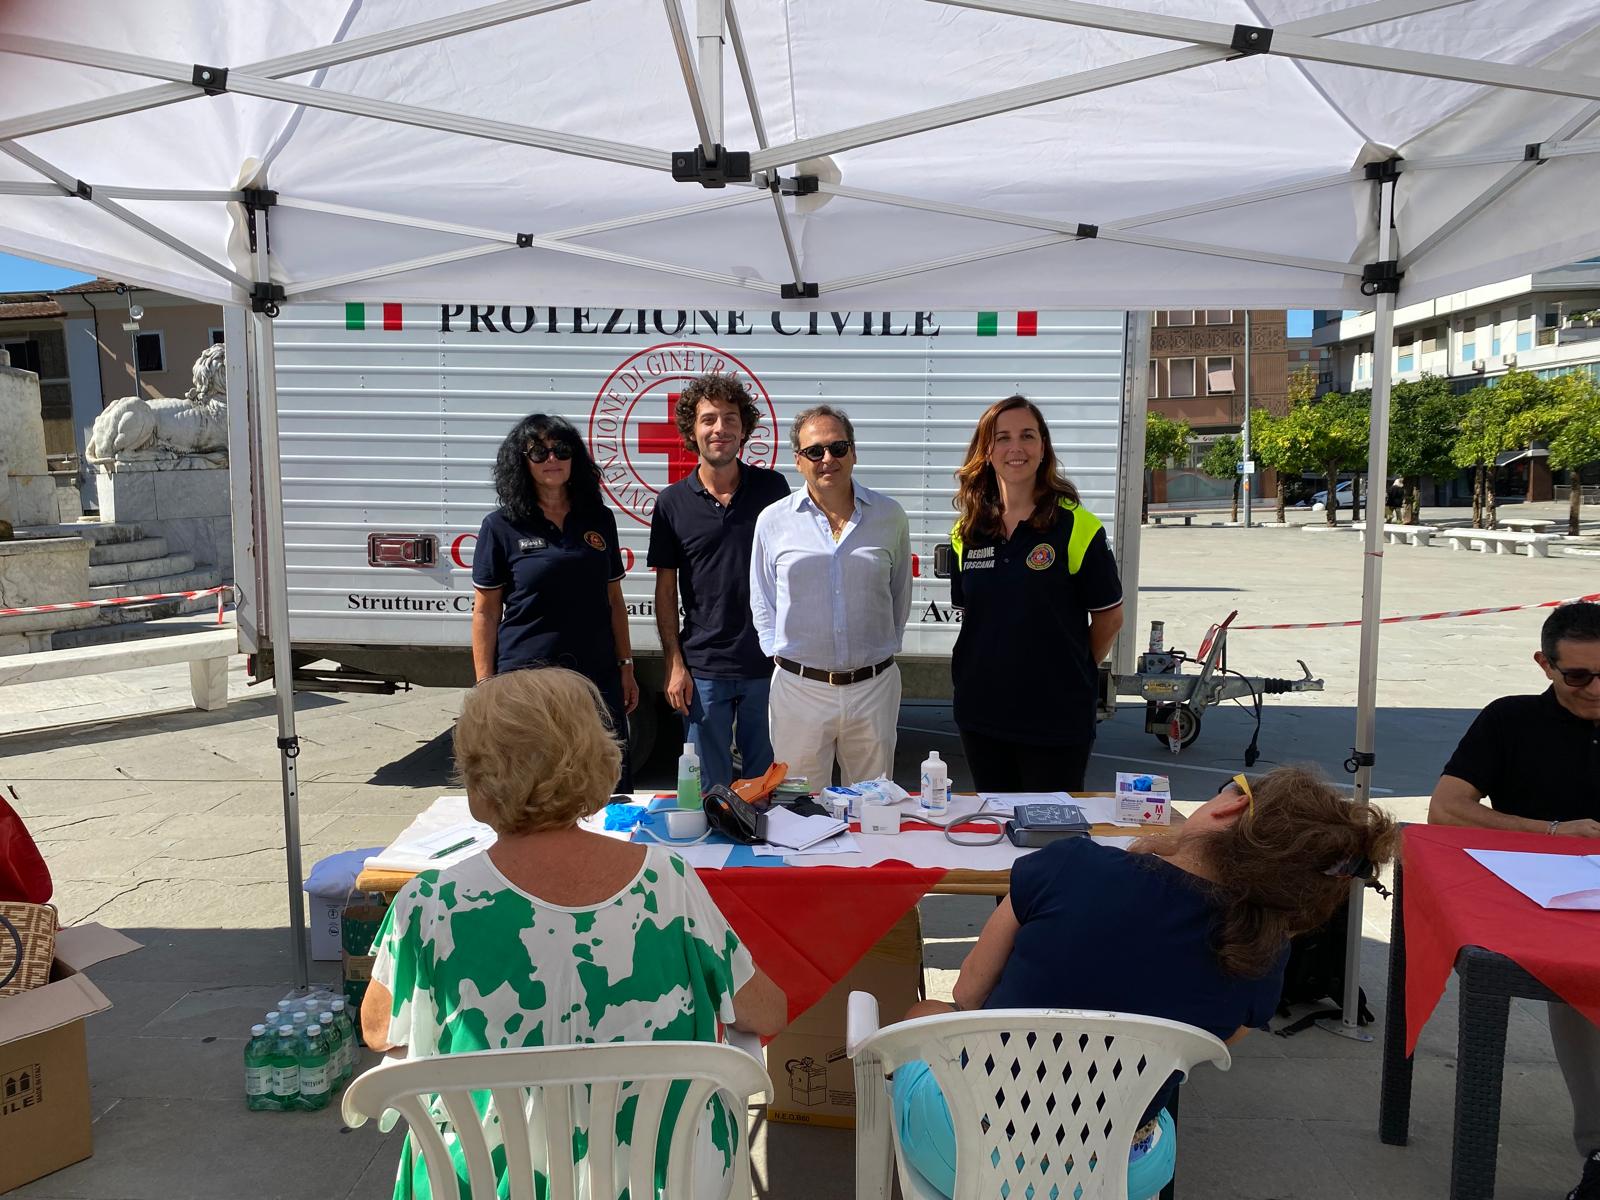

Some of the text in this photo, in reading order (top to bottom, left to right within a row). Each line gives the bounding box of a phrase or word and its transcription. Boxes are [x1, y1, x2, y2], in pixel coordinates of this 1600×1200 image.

[771, 311, 941, 336] CIVILE
[620, 366, 647, 393] DI
[597, 388, 657, 517] ONVENZIONE
[967, 546, 995, 559] REGIONE
[963, 560, 996, 571] TOSCANA
[348, 593, 446, 611] Strutture
[921, 600, 964, 622] Ava
[1155, 804, 1163, 814] M
[3, 1095, 35, 1115] ILE
